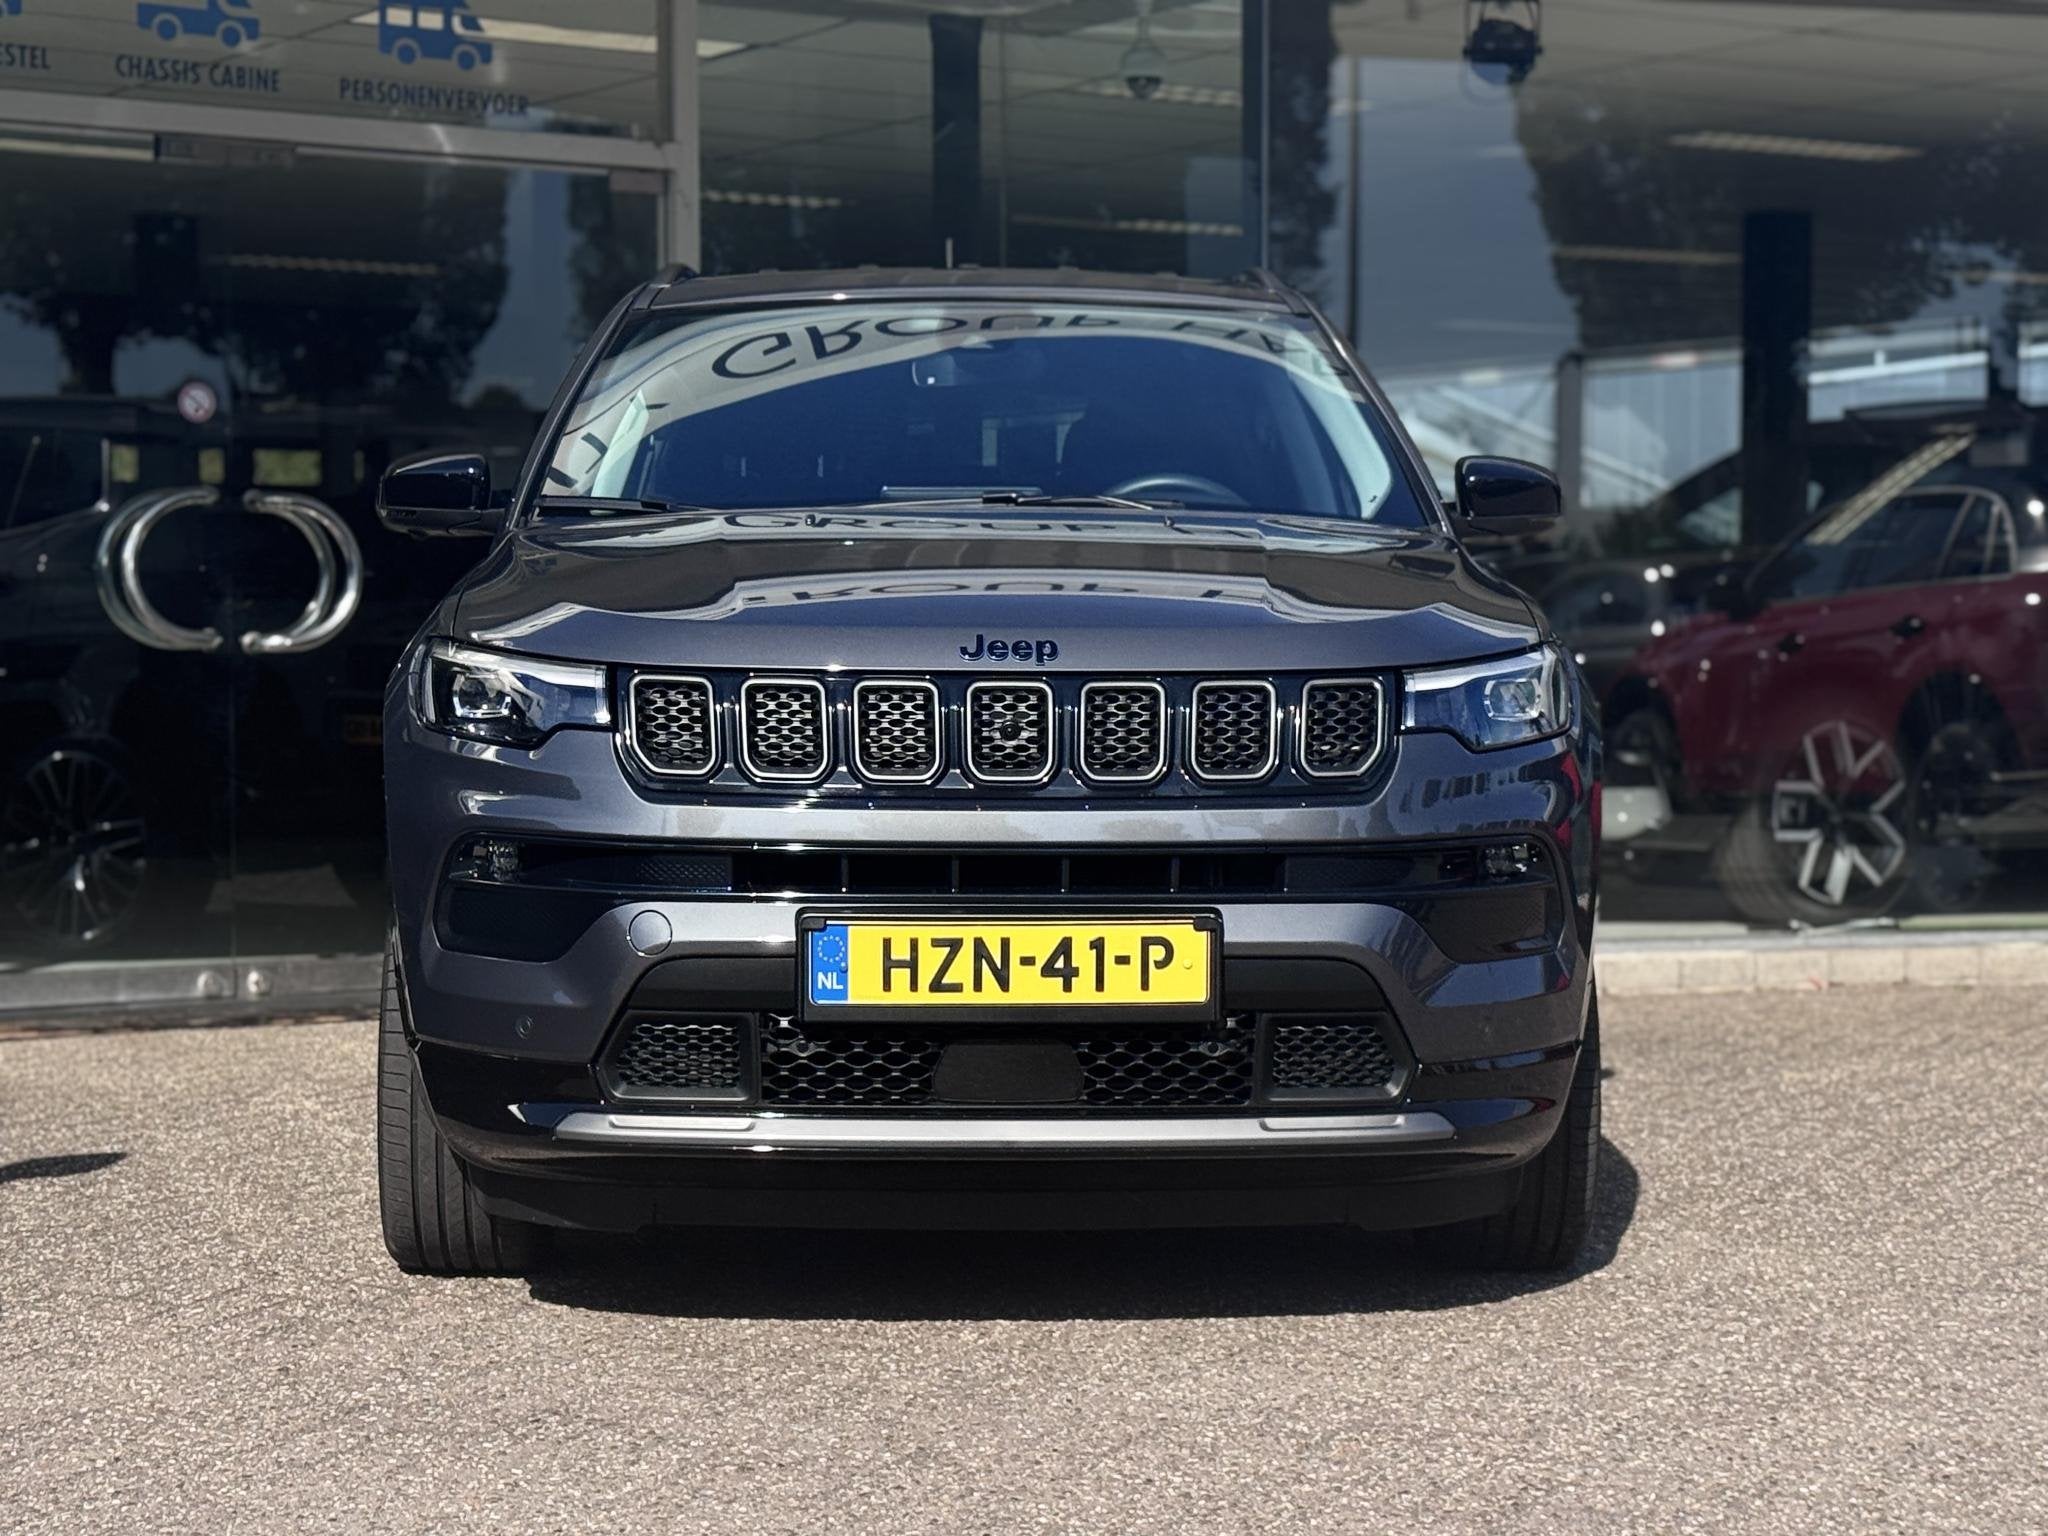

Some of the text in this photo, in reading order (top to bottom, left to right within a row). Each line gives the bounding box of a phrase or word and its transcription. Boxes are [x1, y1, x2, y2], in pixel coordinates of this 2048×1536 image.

[115, 53, 280, 92] CHASSIS CABINE
[339, 77, 529, 115] PERSONENVERVOER
[960, 633, 1059, 666] Jeep
[817, 971, 844, 990] NL
[882, 936, 1175, 992] HZN-41-P
